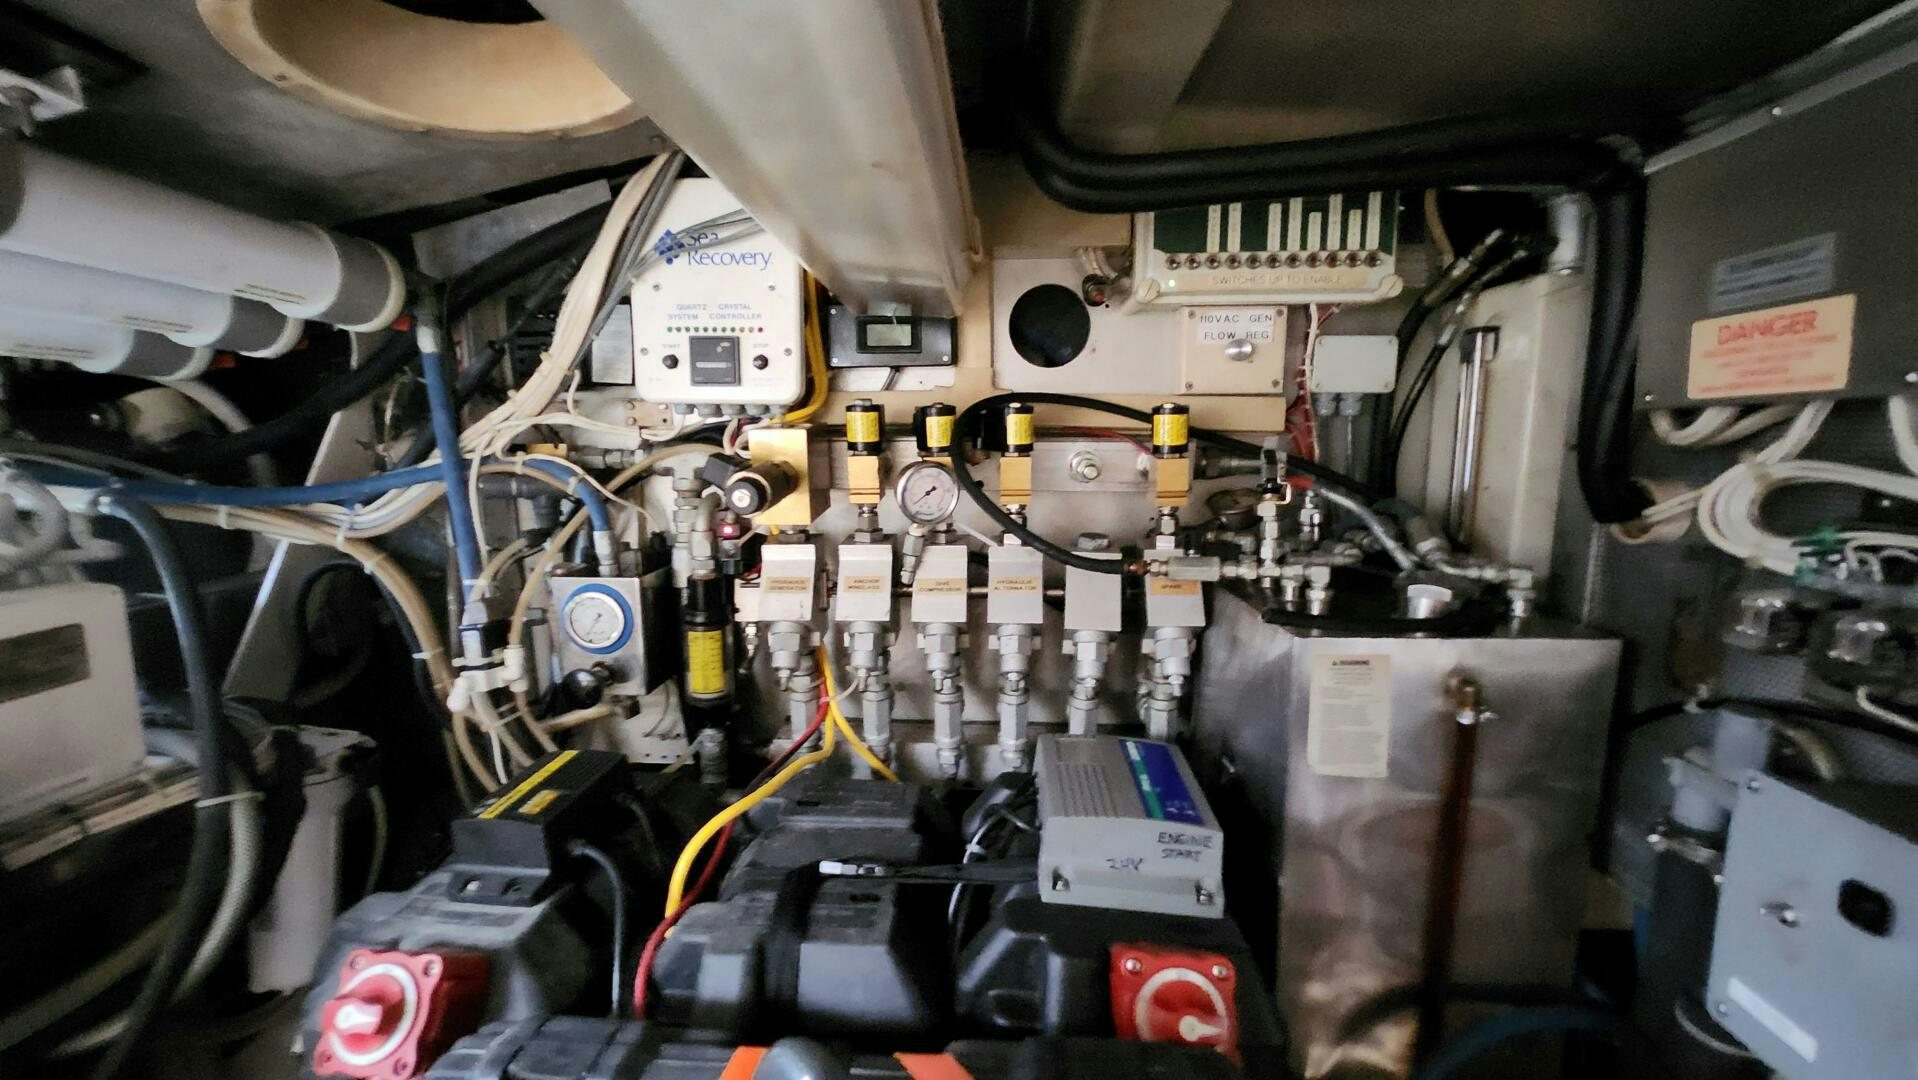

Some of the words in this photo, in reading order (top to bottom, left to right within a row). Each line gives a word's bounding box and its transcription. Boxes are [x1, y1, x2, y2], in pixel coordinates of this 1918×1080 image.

[687, 249, 773, 271] Recovery
[1212, 275, 1265, 285] SWITCHES
[676, 303, 708, 311] QUARTZ
[718, 303, 753, 311] CRYSTAL
[1200, 314, 1240, 324] 110VAC
[1249, 313, 1273, 323] GEN
[1718, 309, 1818, 345] DANGER
[1204, 330, 1237, 340] FLOW
[1246, 330, 1270, 340] REG
[1157, 831, 1214, 849] ENGINE
[1161, 848, 1202, 863] START
[1104, 857, 1144, 872] 24V
